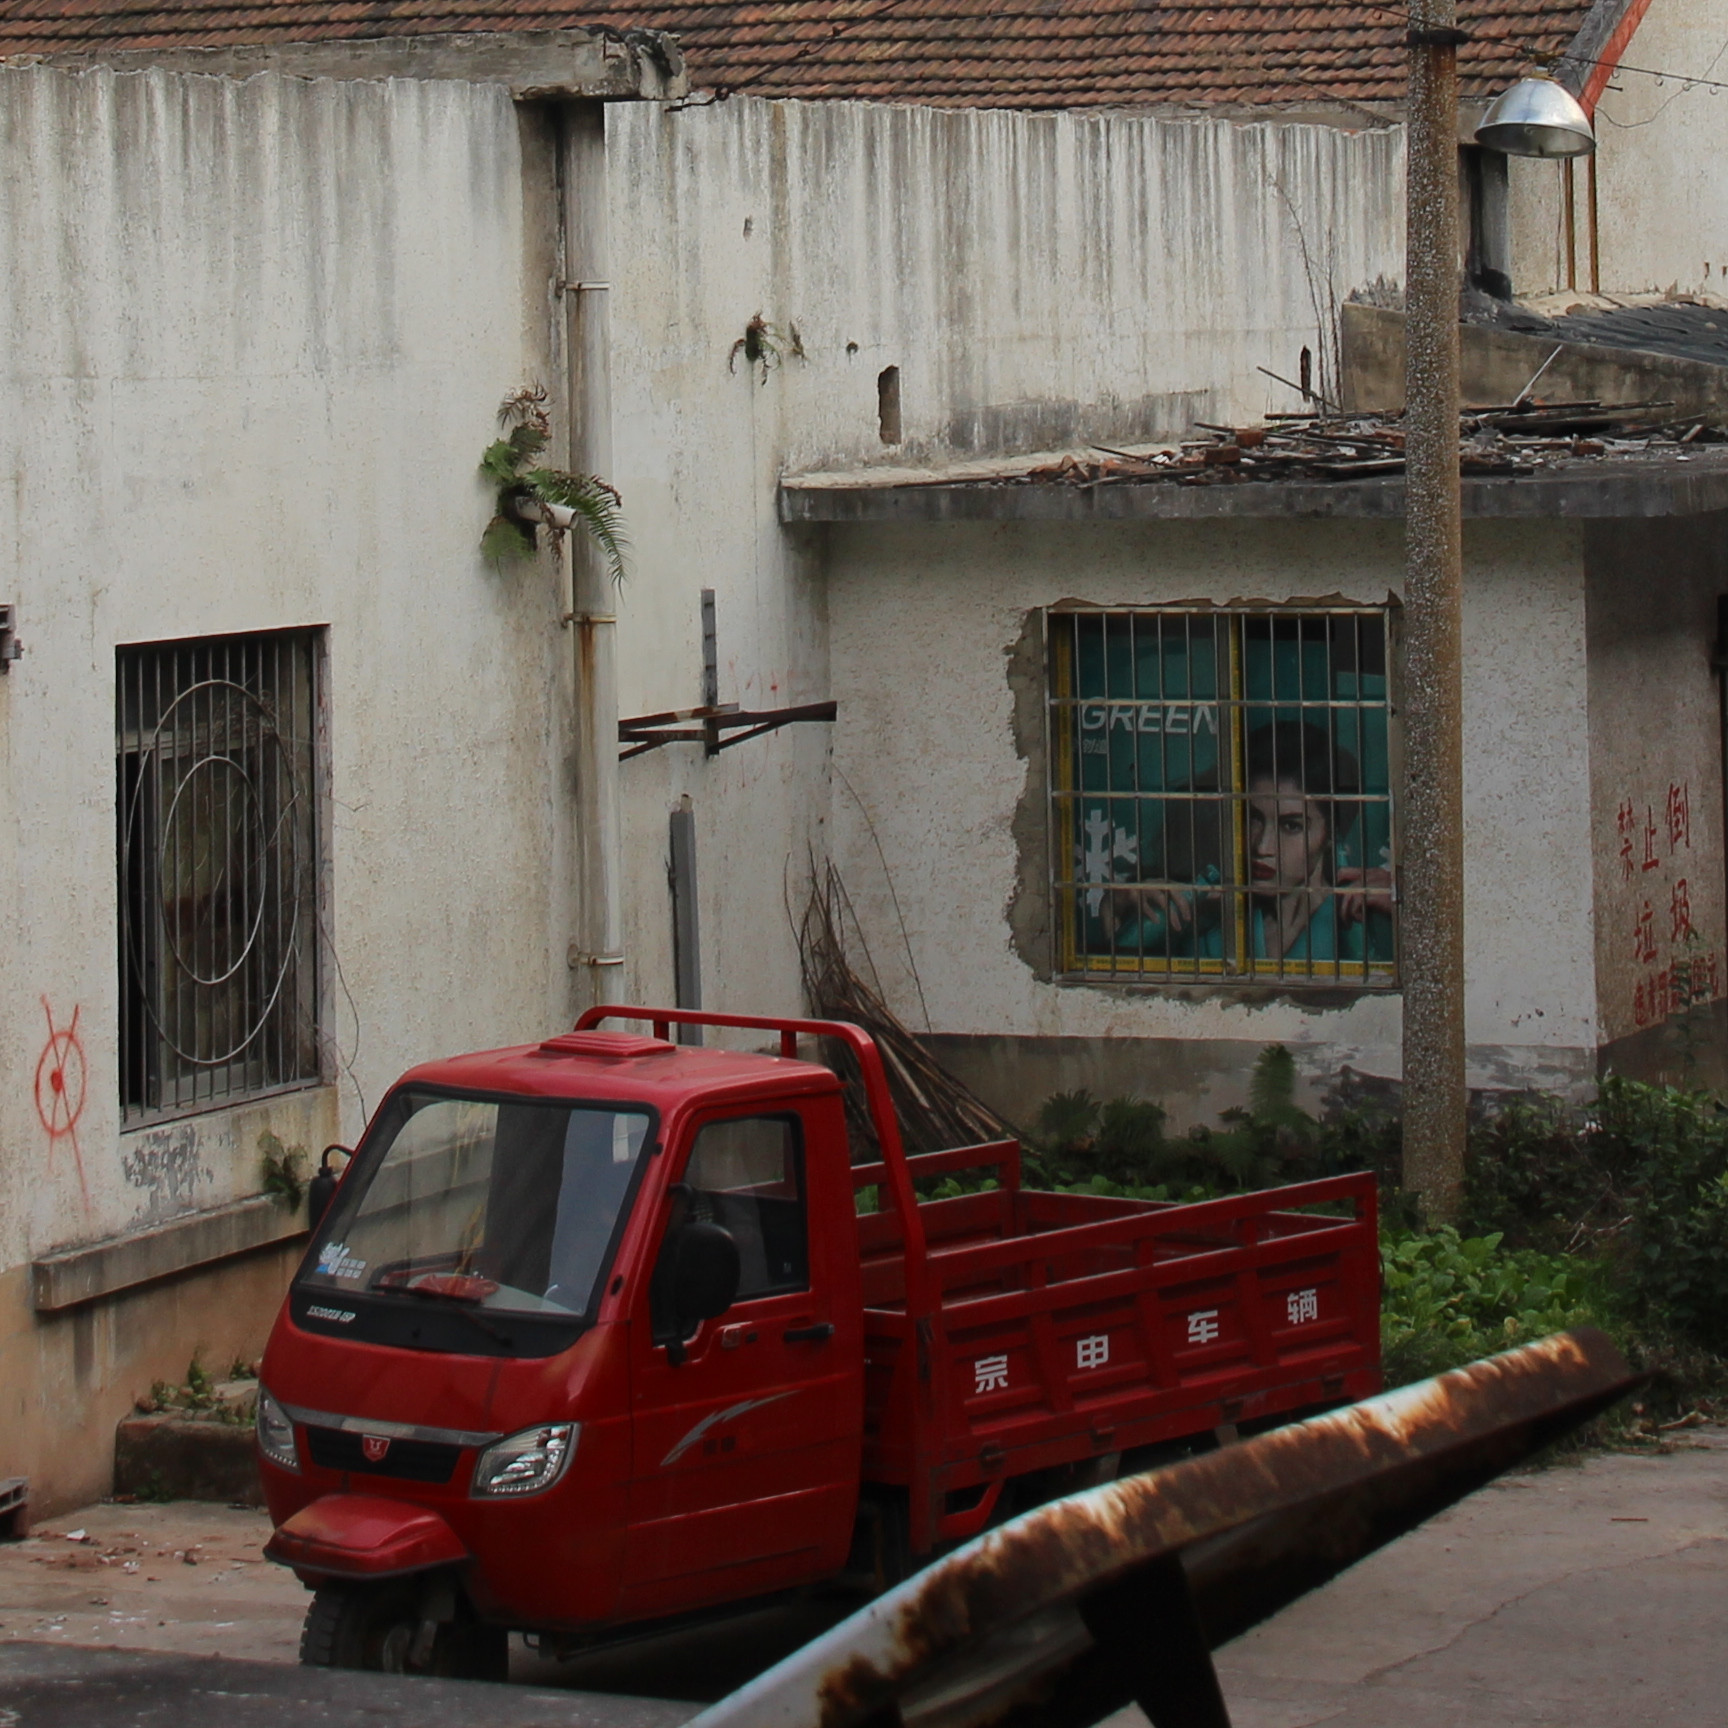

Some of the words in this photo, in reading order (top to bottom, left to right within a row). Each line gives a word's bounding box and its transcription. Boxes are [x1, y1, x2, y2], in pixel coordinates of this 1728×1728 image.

[1081, 696, 1219, 734] GREEN
[974, 1288, 1318, 1394] 宗申车辆
